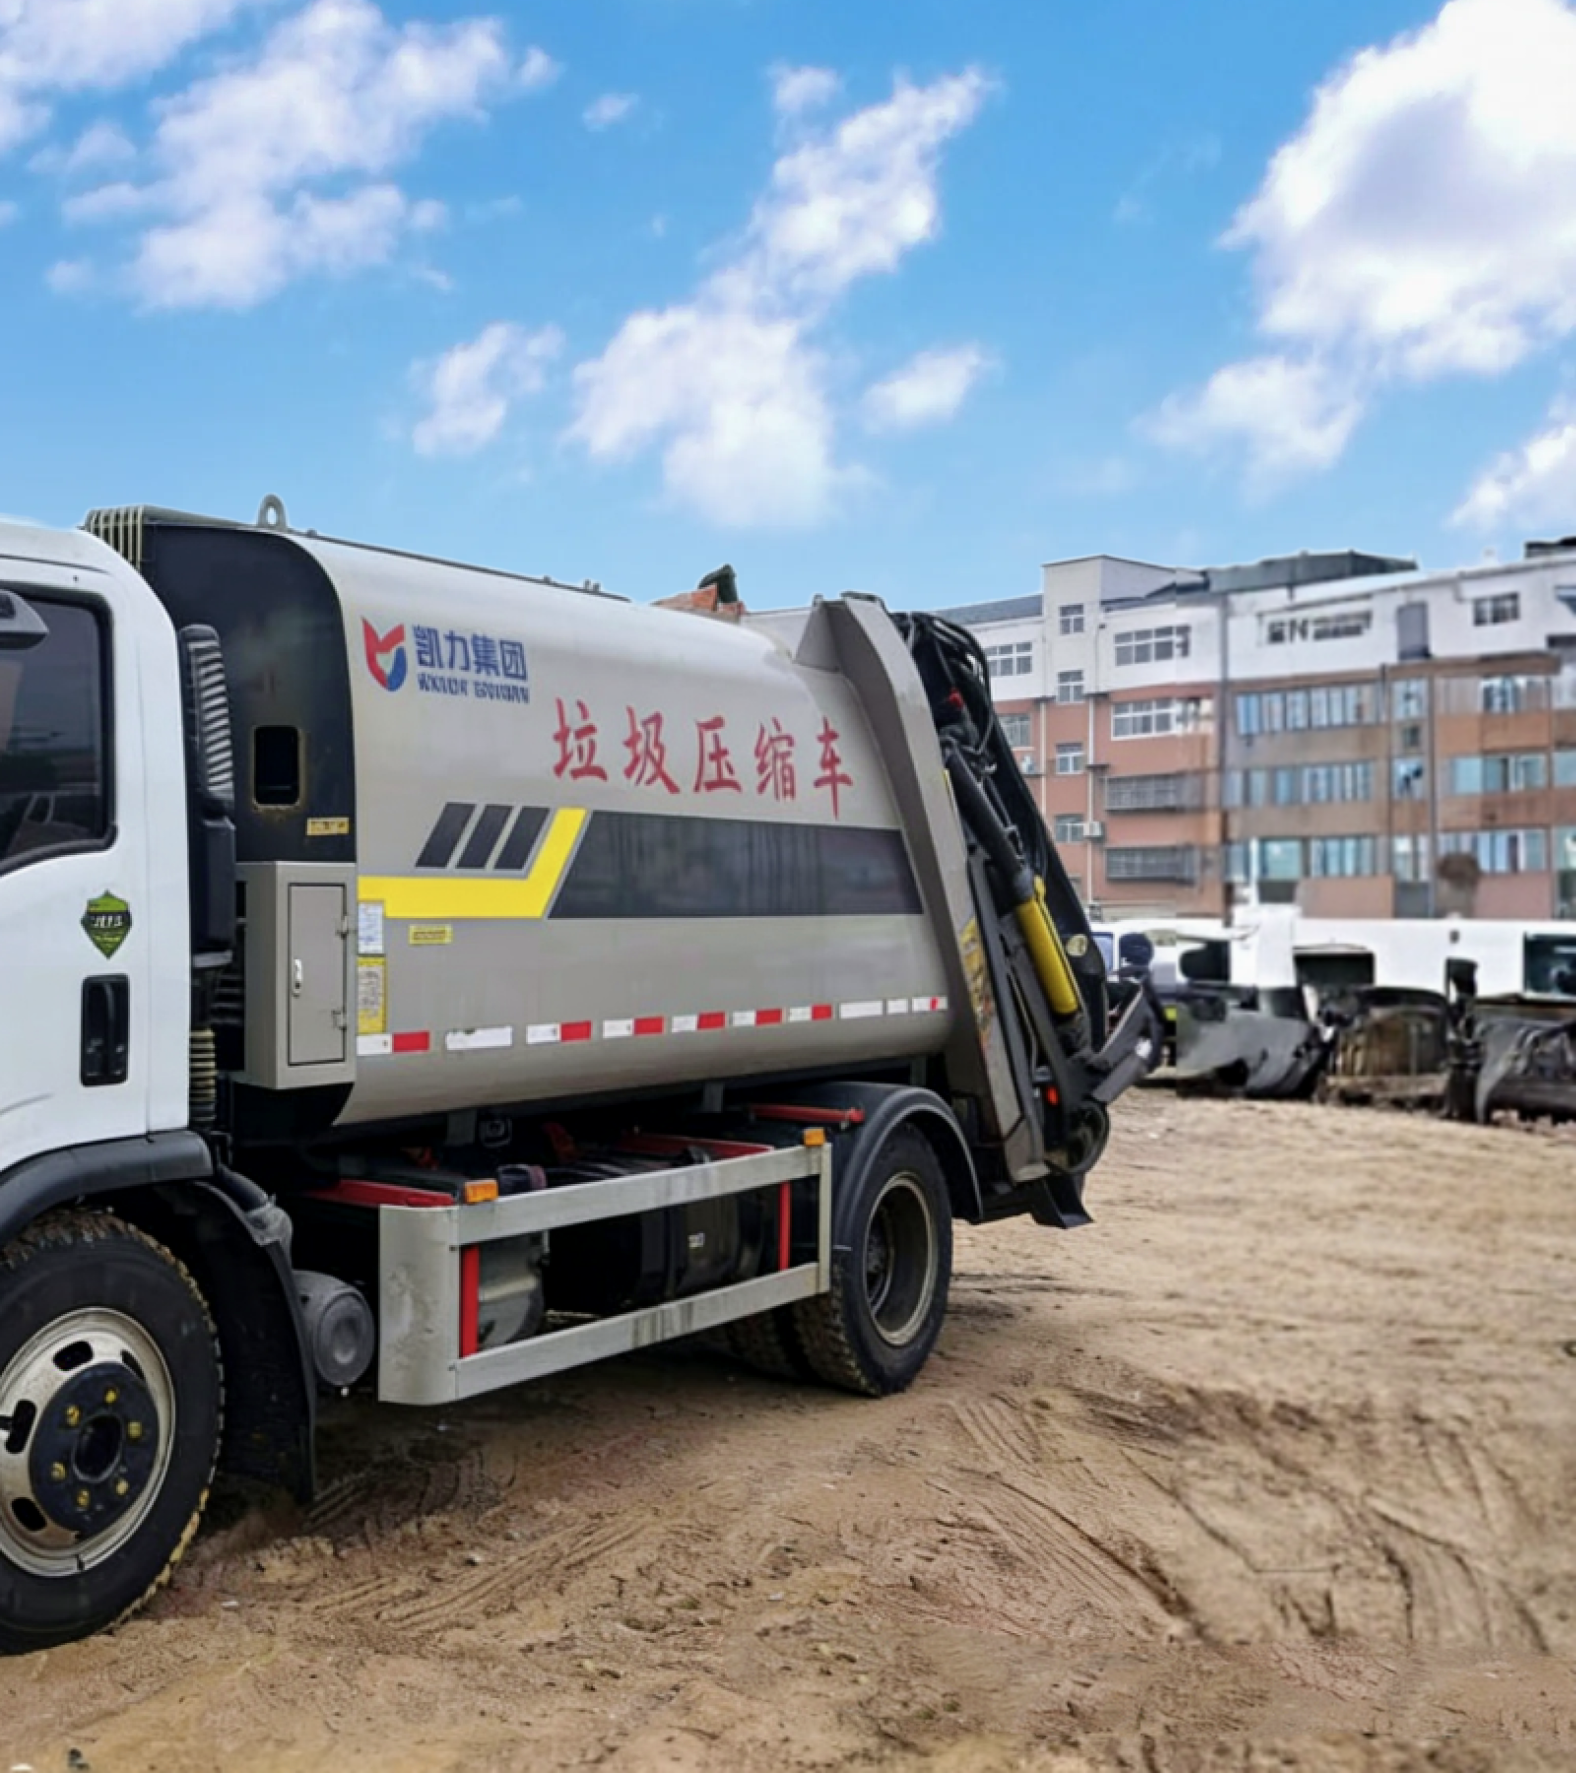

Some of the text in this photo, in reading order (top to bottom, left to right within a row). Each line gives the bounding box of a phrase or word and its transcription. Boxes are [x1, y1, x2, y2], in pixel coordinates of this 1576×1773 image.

[412, 624, 528, 682] 凯力集团
[553, 697, 854, 820] 垃圾压缩车
